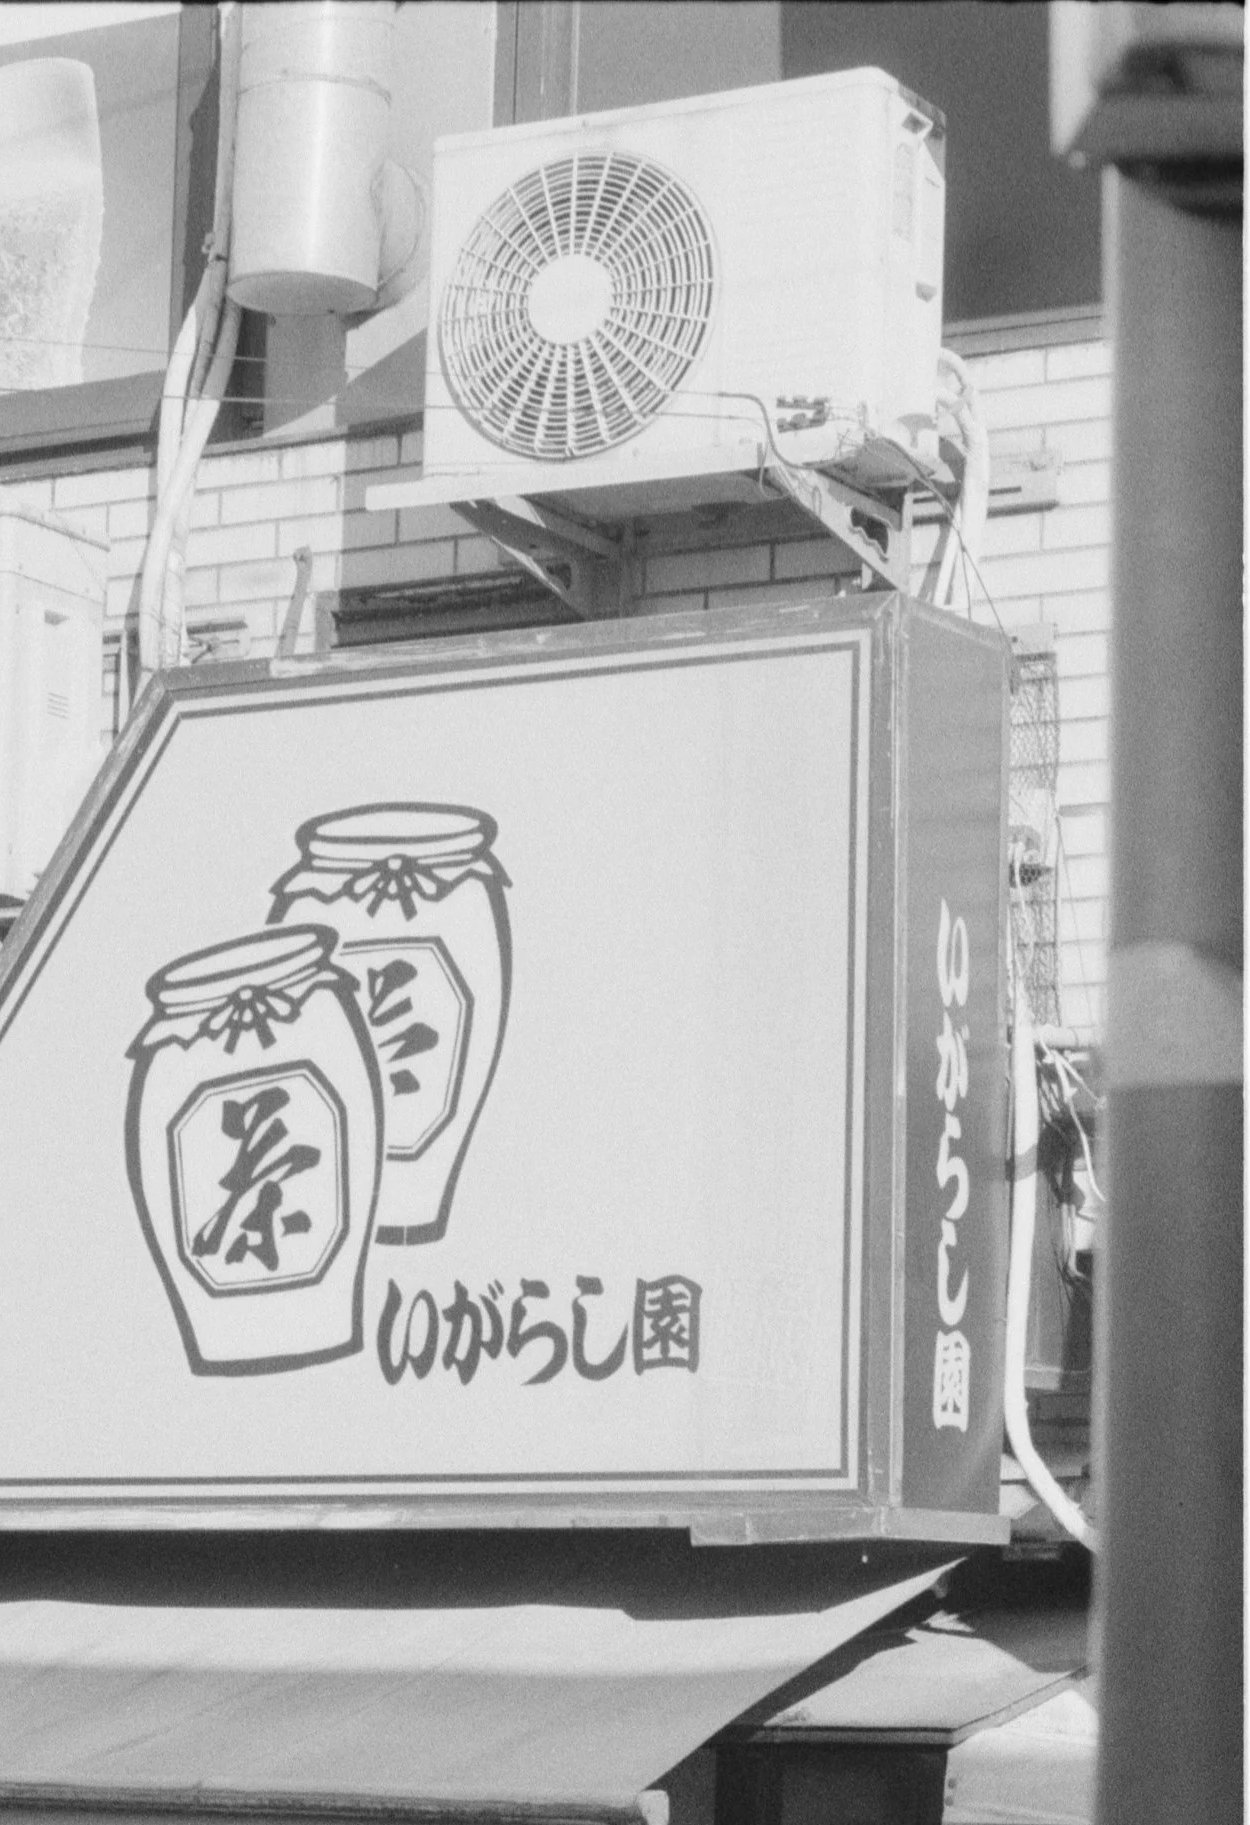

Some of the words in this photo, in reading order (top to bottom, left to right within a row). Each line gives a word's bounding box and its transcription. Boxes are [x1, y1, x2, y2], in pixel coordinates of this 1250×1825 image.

[191, 1085, 322, 1271] 茶
[932, 897, 971, 1432] いがらし園
[376, 1273, 704, 1387] いがらし園
